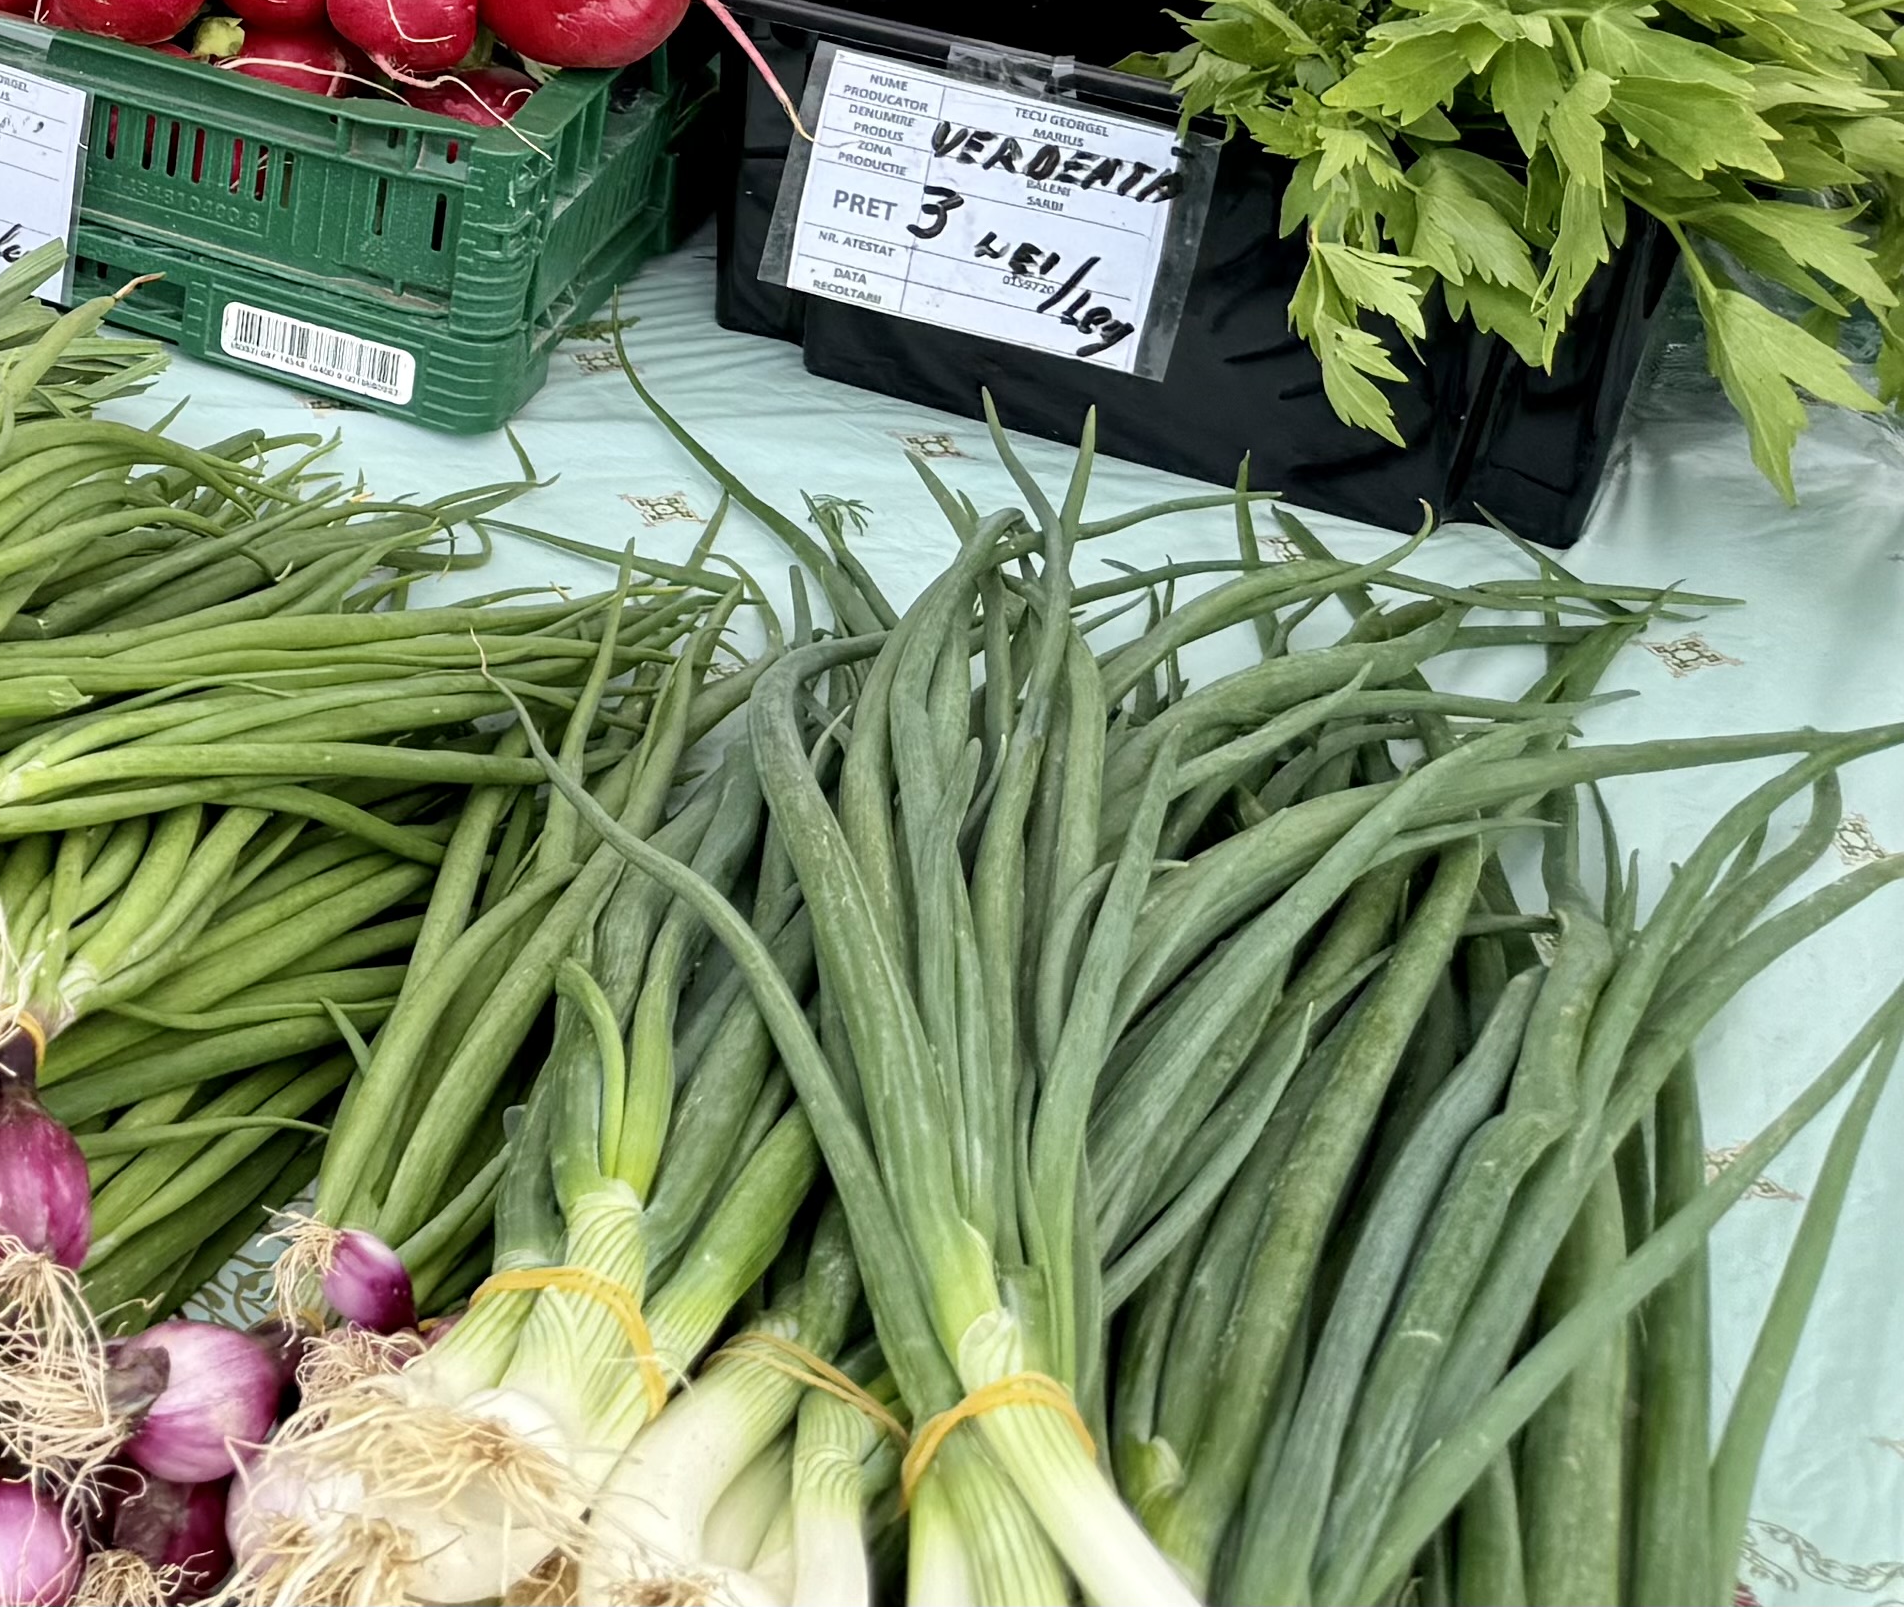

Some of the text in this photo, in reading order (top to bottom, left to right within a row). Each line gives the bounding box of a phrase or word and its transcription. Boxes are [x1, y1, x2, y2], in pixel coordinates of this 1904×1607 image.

[870, 73, 908, 93] NUME
[843, 84, 929, 113] PRODUCATOR
[848, 103, 916, 128] DENUMIRE
[1014, 107, 1109, 138] TECU GEORGEL
[853, 121, 904, 142] PRODUS
[1032, 127, 1085, 149] MARIUS
[857, 139, 893, 158] ZONA
[838, 151, 908, 177] PRODUCTIE
[832, 189, 898, 222] PRET
[906, 185, 964, 240] 3
[818, 230, 839, 245] NR.
[843, 236, 896, 258] ATESTAT
[833, 267, 867, 286] DATA
